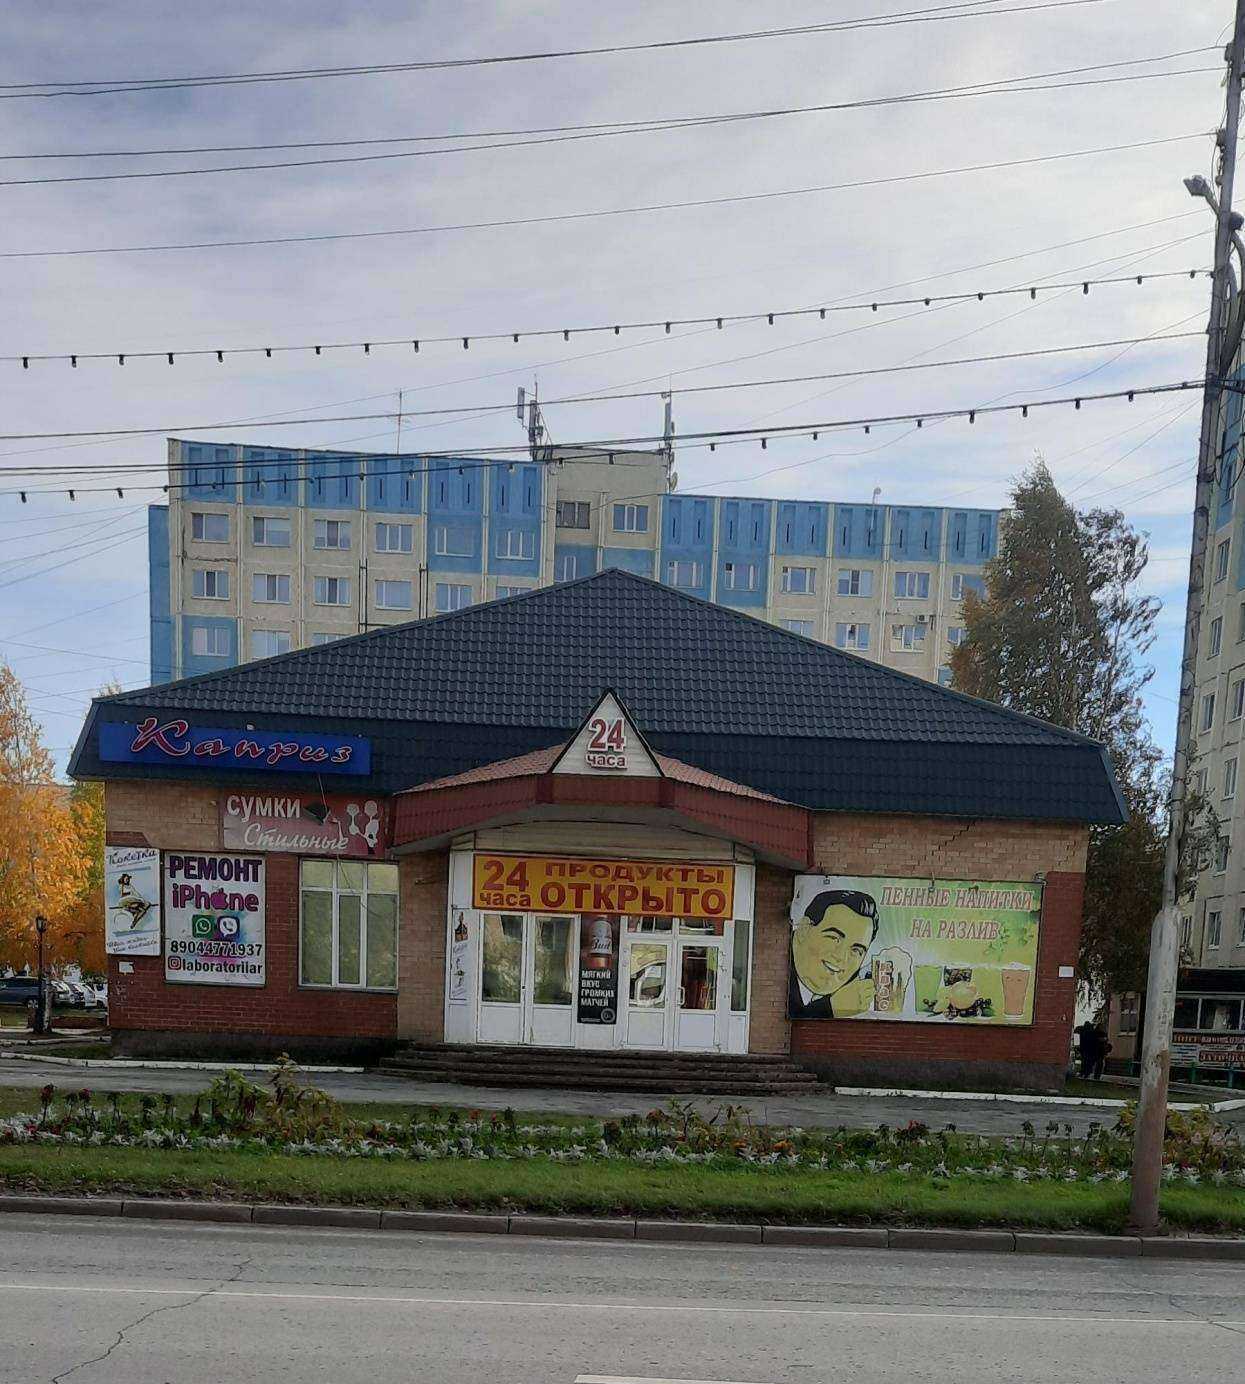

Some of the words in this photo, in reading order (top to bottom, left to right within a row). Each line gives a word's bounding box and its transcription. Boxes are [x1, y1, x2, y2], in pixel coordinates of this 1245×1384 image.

[131, 717, 352, 765] Каприз
[588, 718, 626, 752] 24
[586, 753, 628, 769] часа
[244, 823, 349, 850] Стильные
[169, 855, 263, 883] РЕМОНТ
[482, 859, 530, 892] 24
[544, 861, 725, 884] ПРОДУКТЫ
[479, 891, 532, 907] часа
[540, 881, 727, 915] ОТКРЫТО
[880, 886, 950, 907] ПЕННЫЕ
[954, 887, 1034, 911] НАПИТКИ
[910, 918, 932, 938] НА
[936, 919, 1000, 941] РАЗЛИВ
[170, 940, 263, 957] 89044771937
